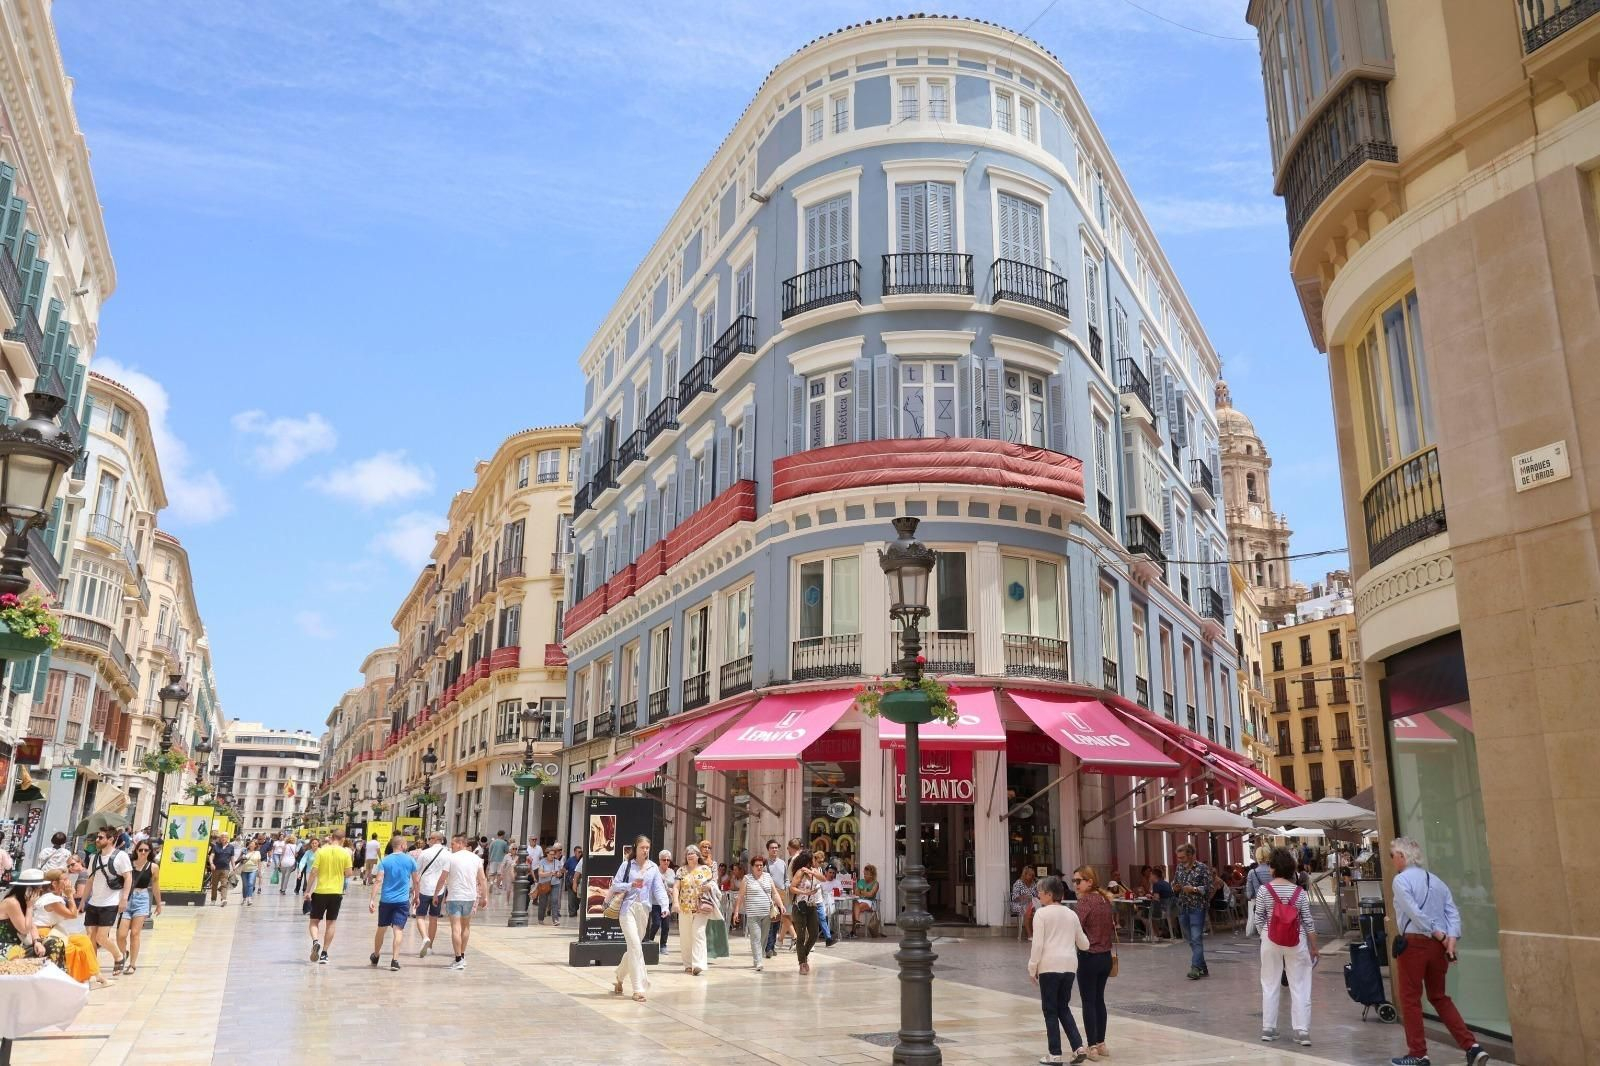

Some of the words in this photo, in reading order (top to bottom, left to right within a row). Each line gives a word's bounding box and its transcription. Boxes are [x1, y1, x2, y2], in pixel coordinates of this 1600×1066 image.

[813, 403, 822, 447] Medicina
[838, 397, 848, 442] Estética
[1519, 456, 1532, 465] CALLE
[1521, 476, 1530, 485] DE
[1532, 468, 1554, 481] LARIOS
[897, 773, 973, 799] LPANTO
